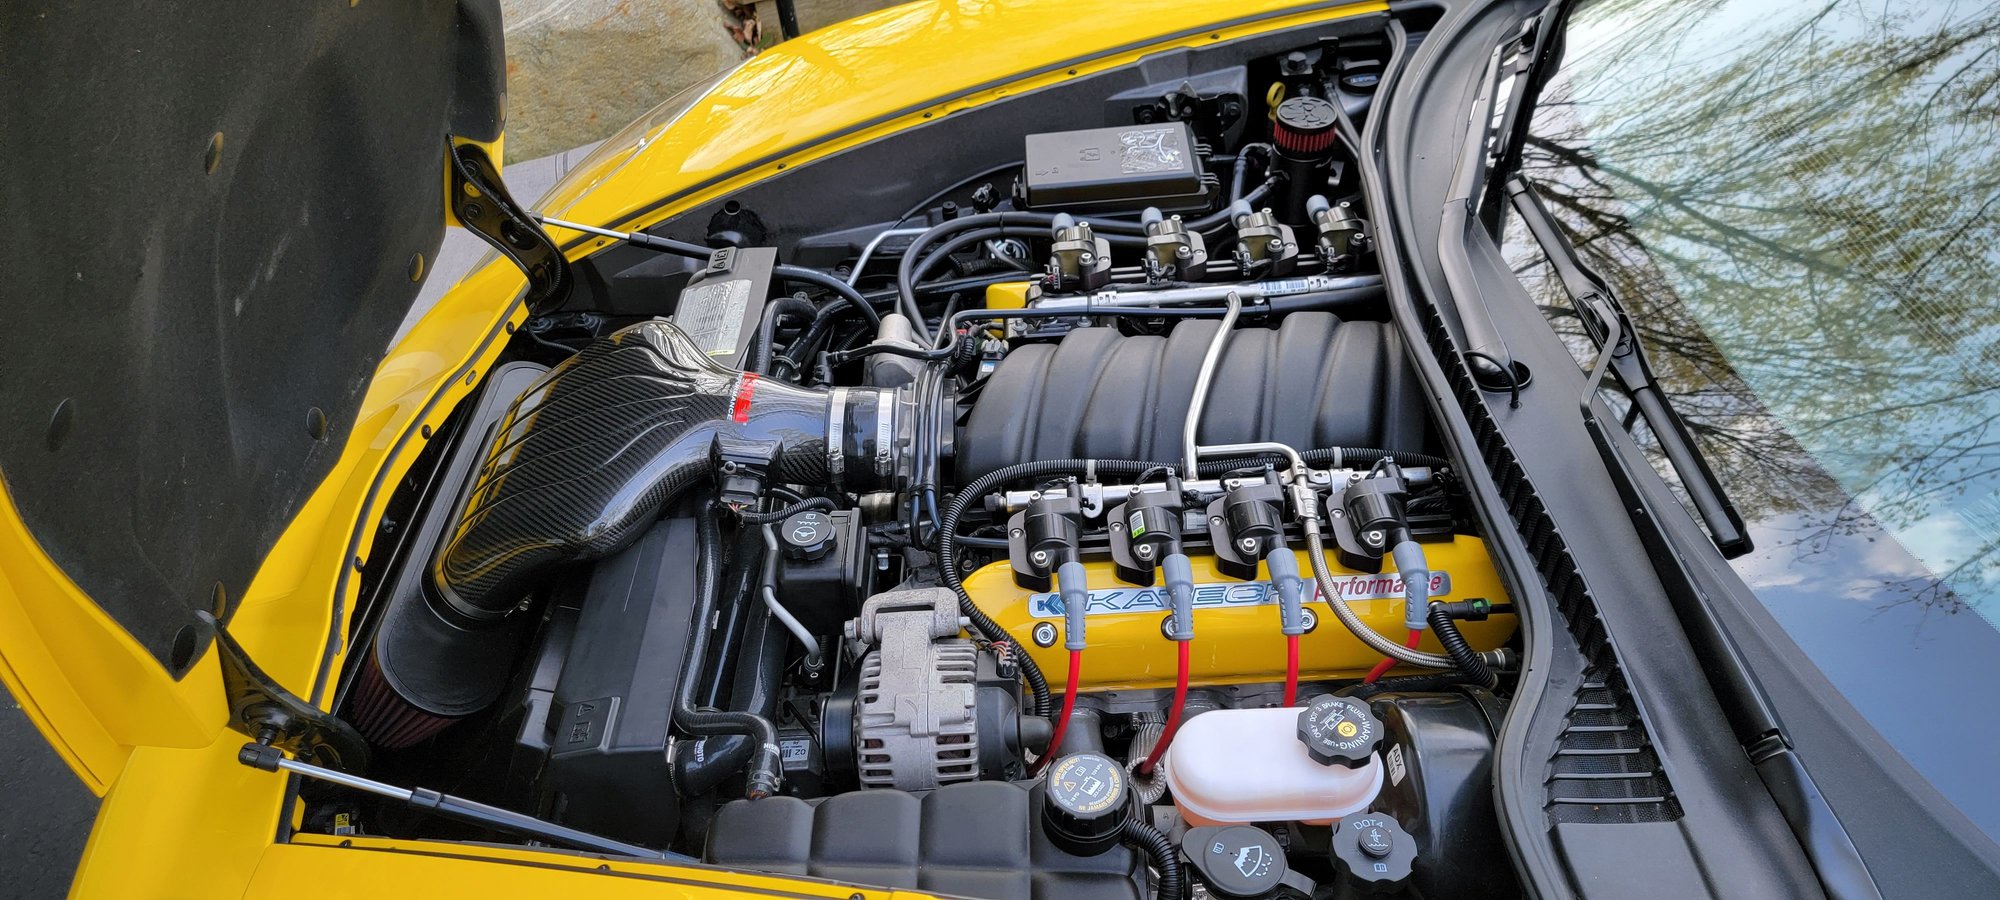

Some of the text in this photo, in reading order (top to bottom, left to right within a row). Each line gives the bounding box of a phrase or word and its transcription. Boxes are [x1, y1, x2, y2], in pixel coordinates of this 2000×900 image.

[1085, 575, 1442, 611] KAECH prformae
[1321, 701, 1344, 709] BRAKE
[1346, 704, 1366, 719] FLUID
[1310, 711, 1319, 722] DOT
[1310, 725, 1322, 738] ONLY
[1339, 720, 1372, 750] WARNING
[1322, 738, 1336, 748] USE
[1393, 748, 1403, 770] ADX
